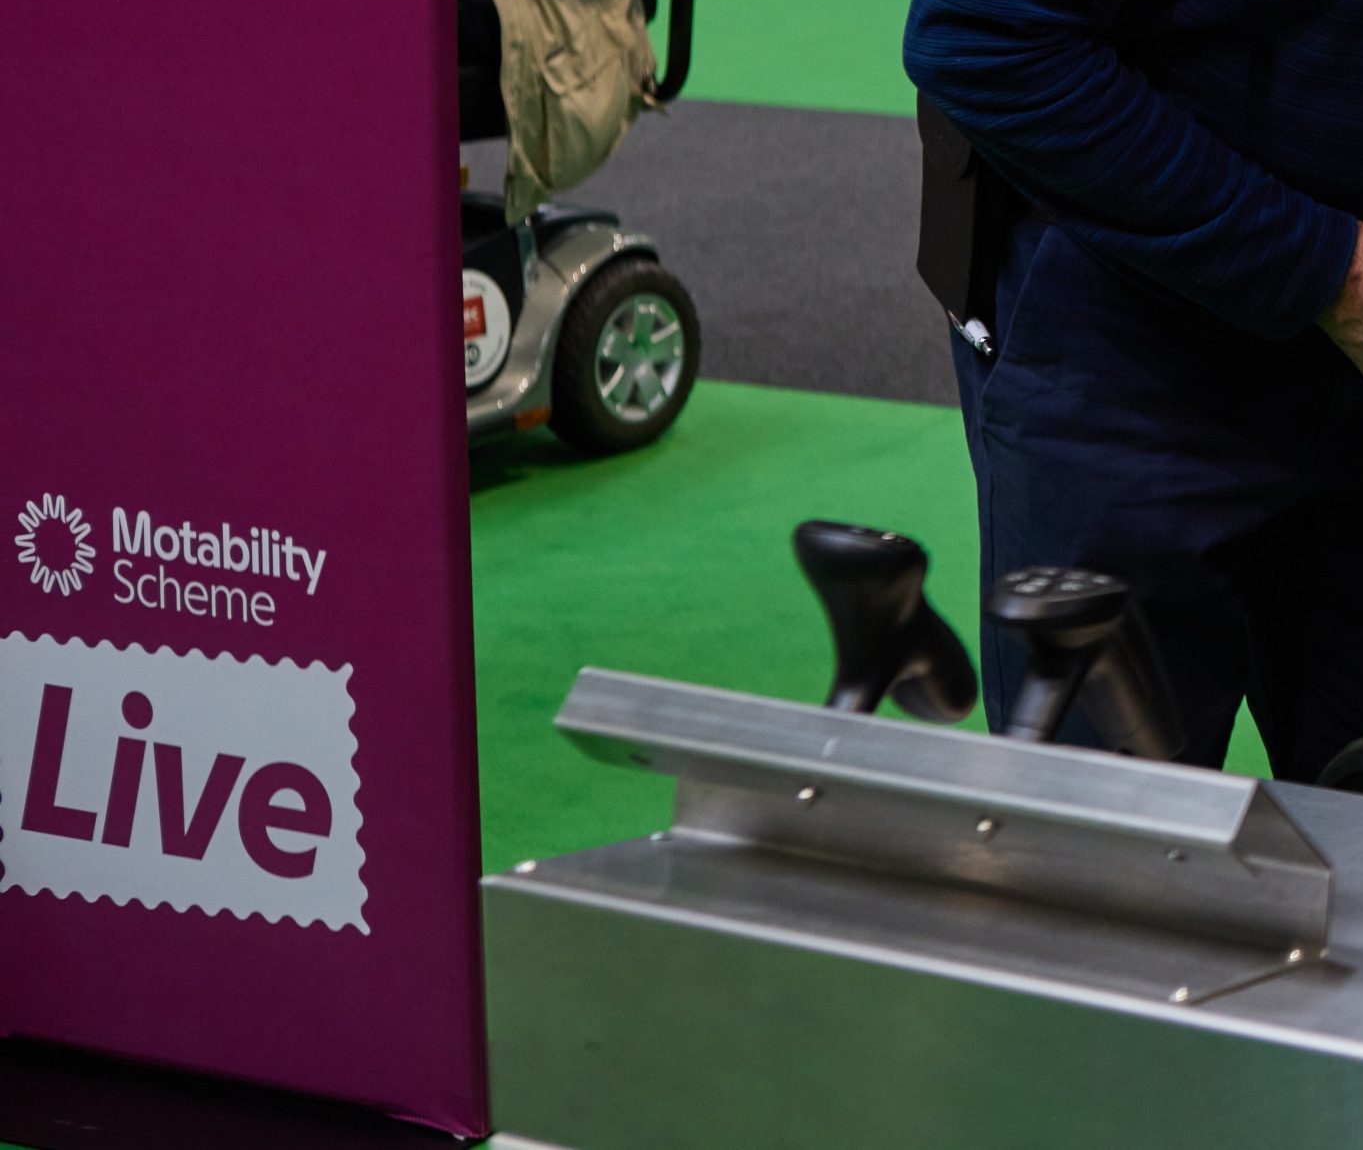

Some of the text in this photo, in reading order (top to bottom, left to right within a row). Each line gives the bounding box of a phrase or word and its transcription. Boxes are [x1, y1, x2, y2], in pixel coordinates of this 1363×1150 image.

[112, 506, 327, 596] Motability
[113, 559, 276, 627] Scheme
[20, 683, 333, 880] Live
